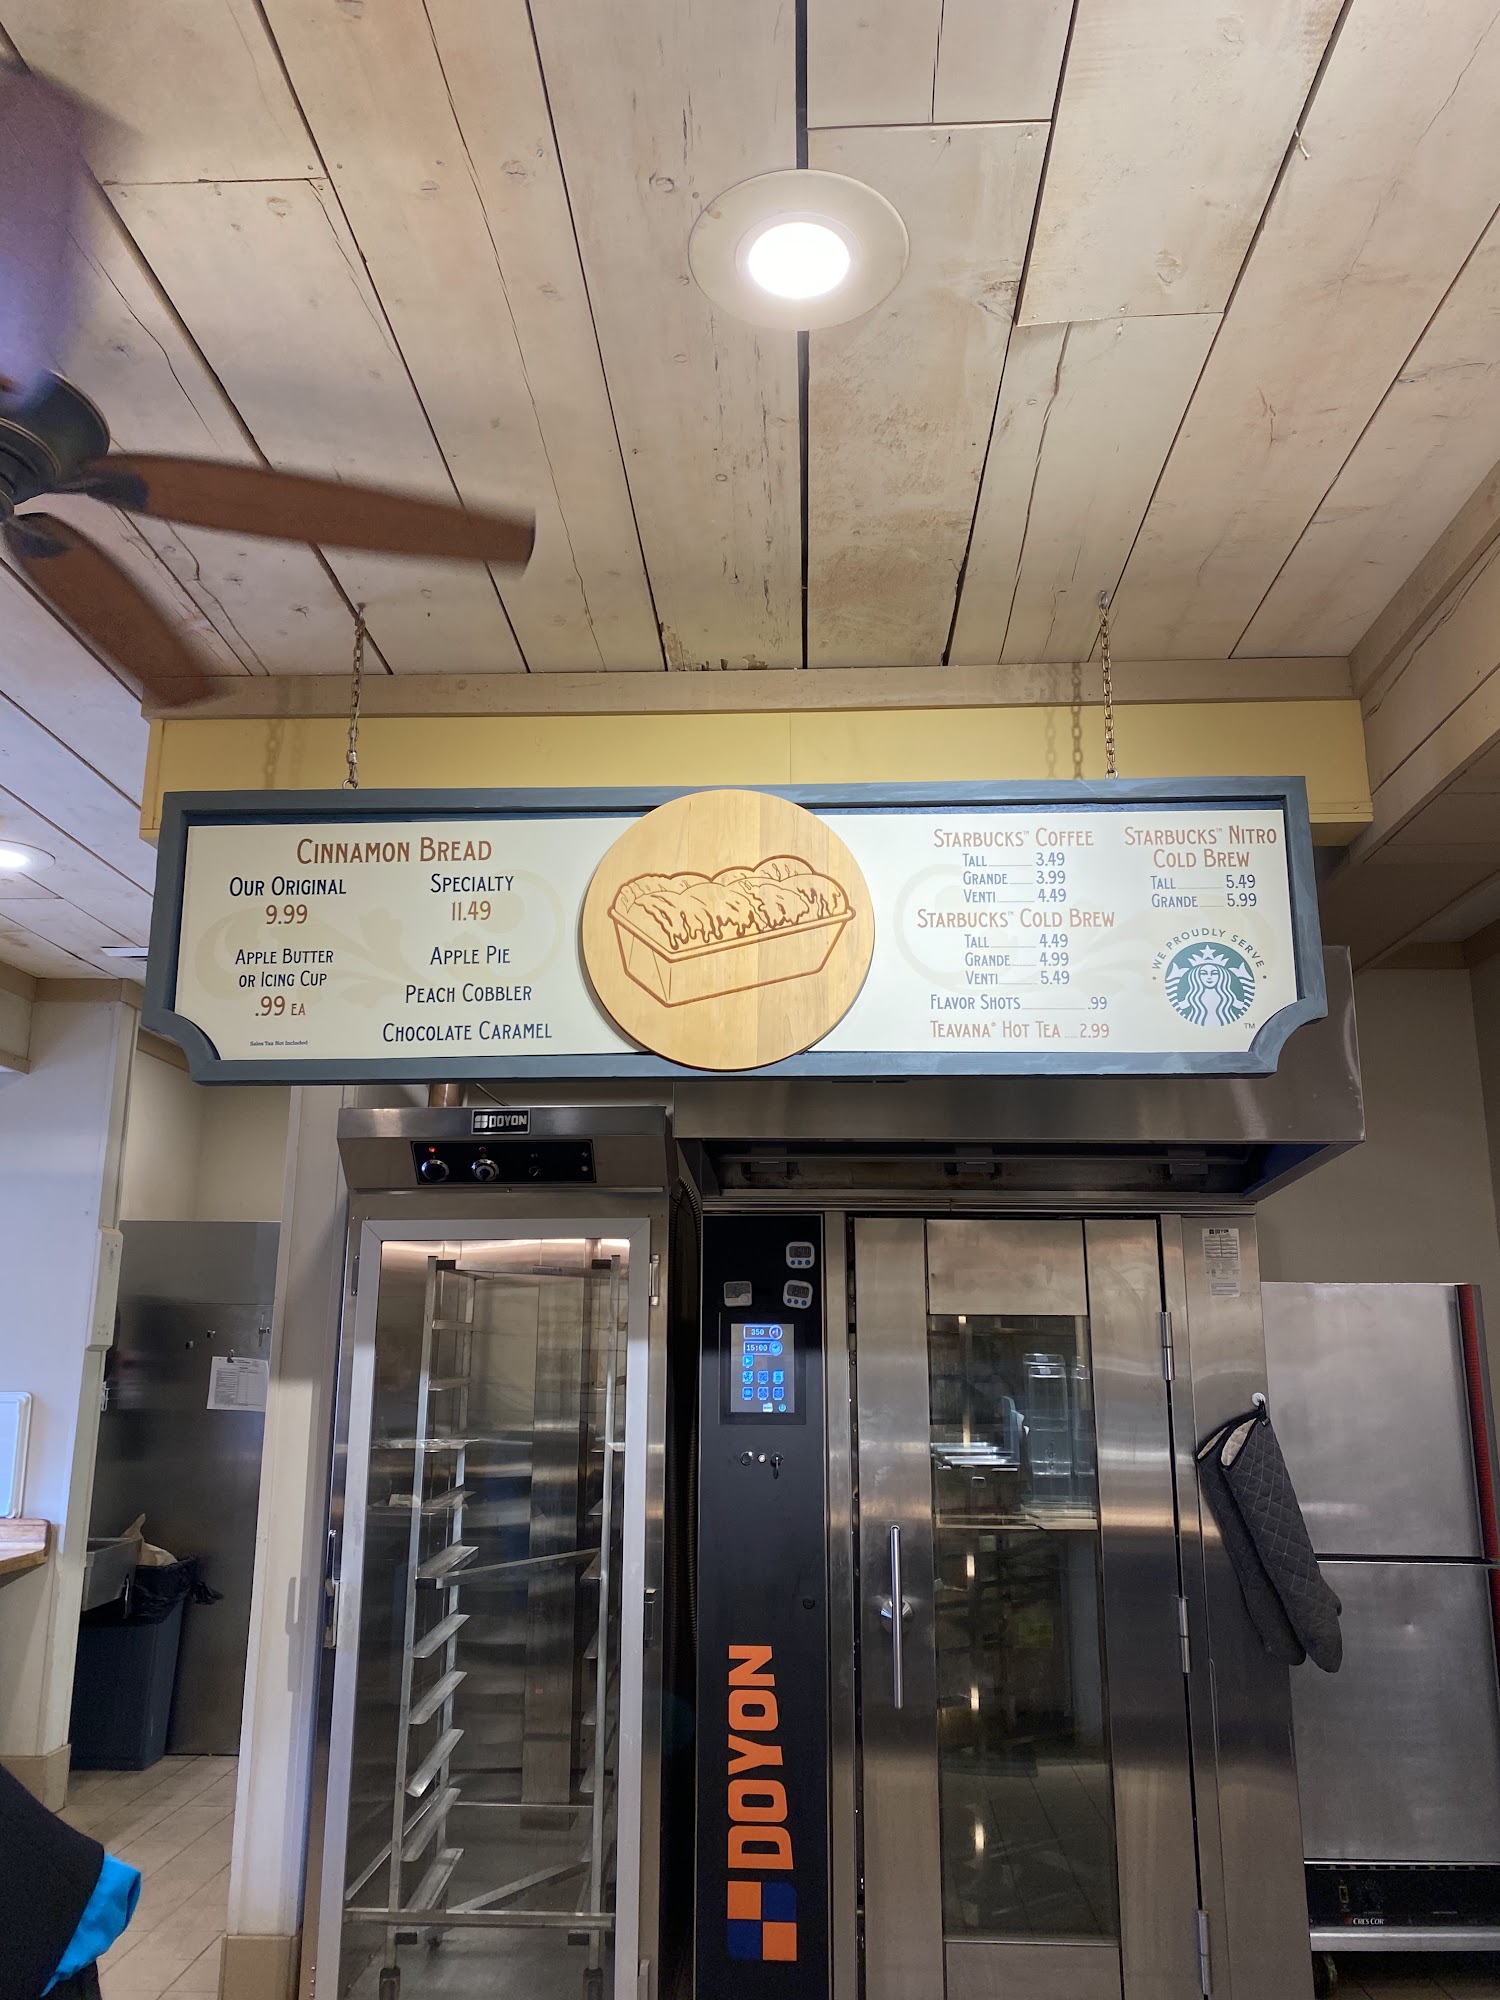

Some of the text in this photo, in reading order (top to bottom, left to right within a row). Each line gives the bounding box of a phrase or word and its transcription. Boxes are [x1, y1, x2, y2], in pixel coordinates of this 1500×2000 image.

[1035, 827, 1094, 846] COFFEE
[1229, 825, 1277, 844] NITRO
[297, 836, 492, 865] CINNAMON BREAD
[962, 852, 1065, 867] TALL 3.49
[1153, 848, 1250, 868] COLD BREW
[229, 875, 347, 897] OUR ORIGINAL
[430, 873, 514, 894] SPECIALTY
[962, 870, 1066, 885] GRANDE 3.99
[1150, 874, 1256, 890] TALL 5.49
[963, 888, 1067, 903] VENTI 4.49
[1151, 892, 1257, 908] GRANDE 5.99
[265, 904, 308, 925] 9.99
[451, 900, 492, 922] 11.49
[1020, 908, 1063, 928] COLD
[1069, 908, 1115, 928] BREW
[964, 933, 1068, 948] TALL 4.49
[1152, 927, 1265, 970] WE PROUDLY SERVE
[235, 948, 334, 965] APPLE BUTTER
[430, 946, 511, 966] APPLE PIE
[964, 951, 1069, 967] GRANDE 4.99
[260, 971, 295, 988] ICING
[300, 971, 328, 987] CUP
[965, 970, 1070, 985] VENTI 5.49
[405, 983, 532, 1004] PEACH COBBLER
[930, 994, 1108, 1010] FLAVOR SHOTS .99
[254, 995, 306, 1017] .99 EA
[382, 1021, 552, 1043] CHOCOLATE CARAMEL
[1002, 1020, 1030, 1038] HOT
[1035, 1020, 1061, 1039] TEA
[1079, 1023, 1110, 1039] 2.99
[488, 1114, 527, 1129] DOYON
[727, 1644, 794, 1870] DOYON
